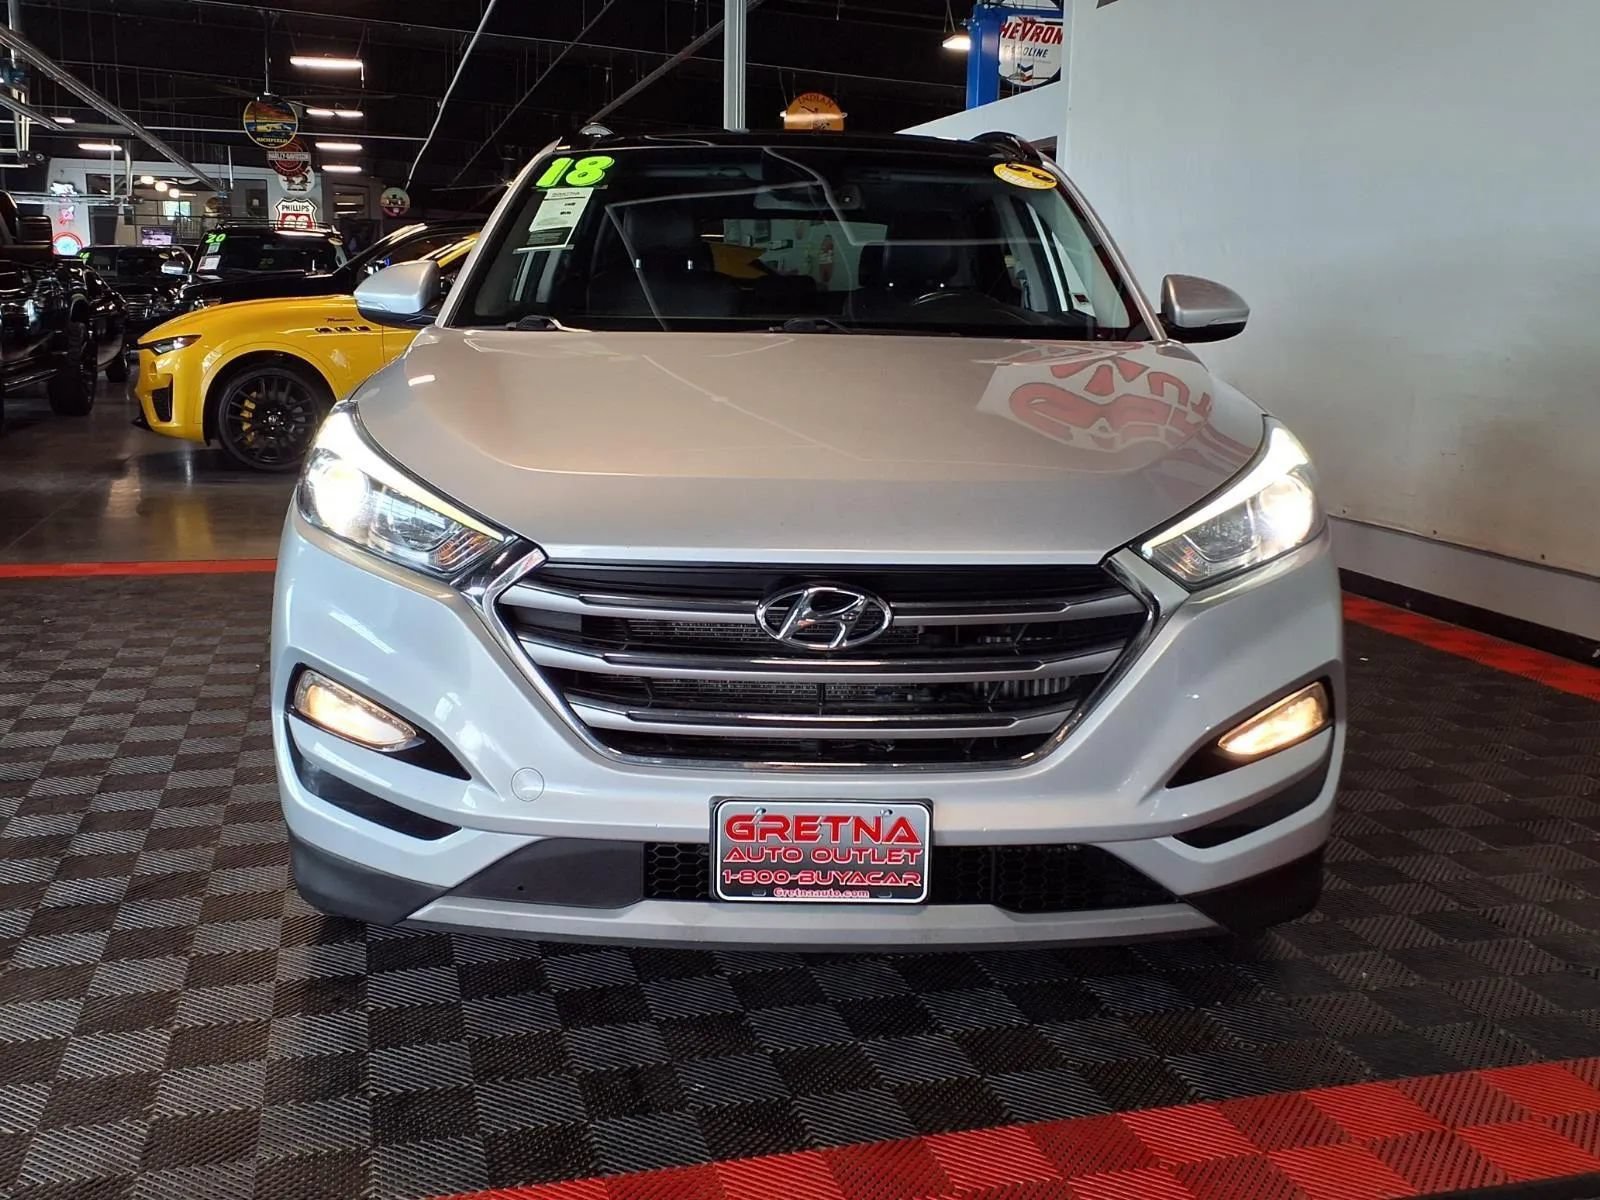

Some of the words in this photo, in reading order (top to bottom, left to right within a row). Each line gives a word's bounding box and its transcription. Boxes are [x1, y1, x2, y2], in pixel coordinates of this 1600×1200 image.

[1000, 21, 1063, 45] HEVRON
[536, 156, 615, 187] 18
[281, 204, 310, 212] PHILLIPS
[725, 815, 922, 845] GRETNA
[723, 846, 803, 863] AUTO
[811, 848, 923, 865] OUTLET
[723, 869, 922, 887] 1-800-BUYACAR
